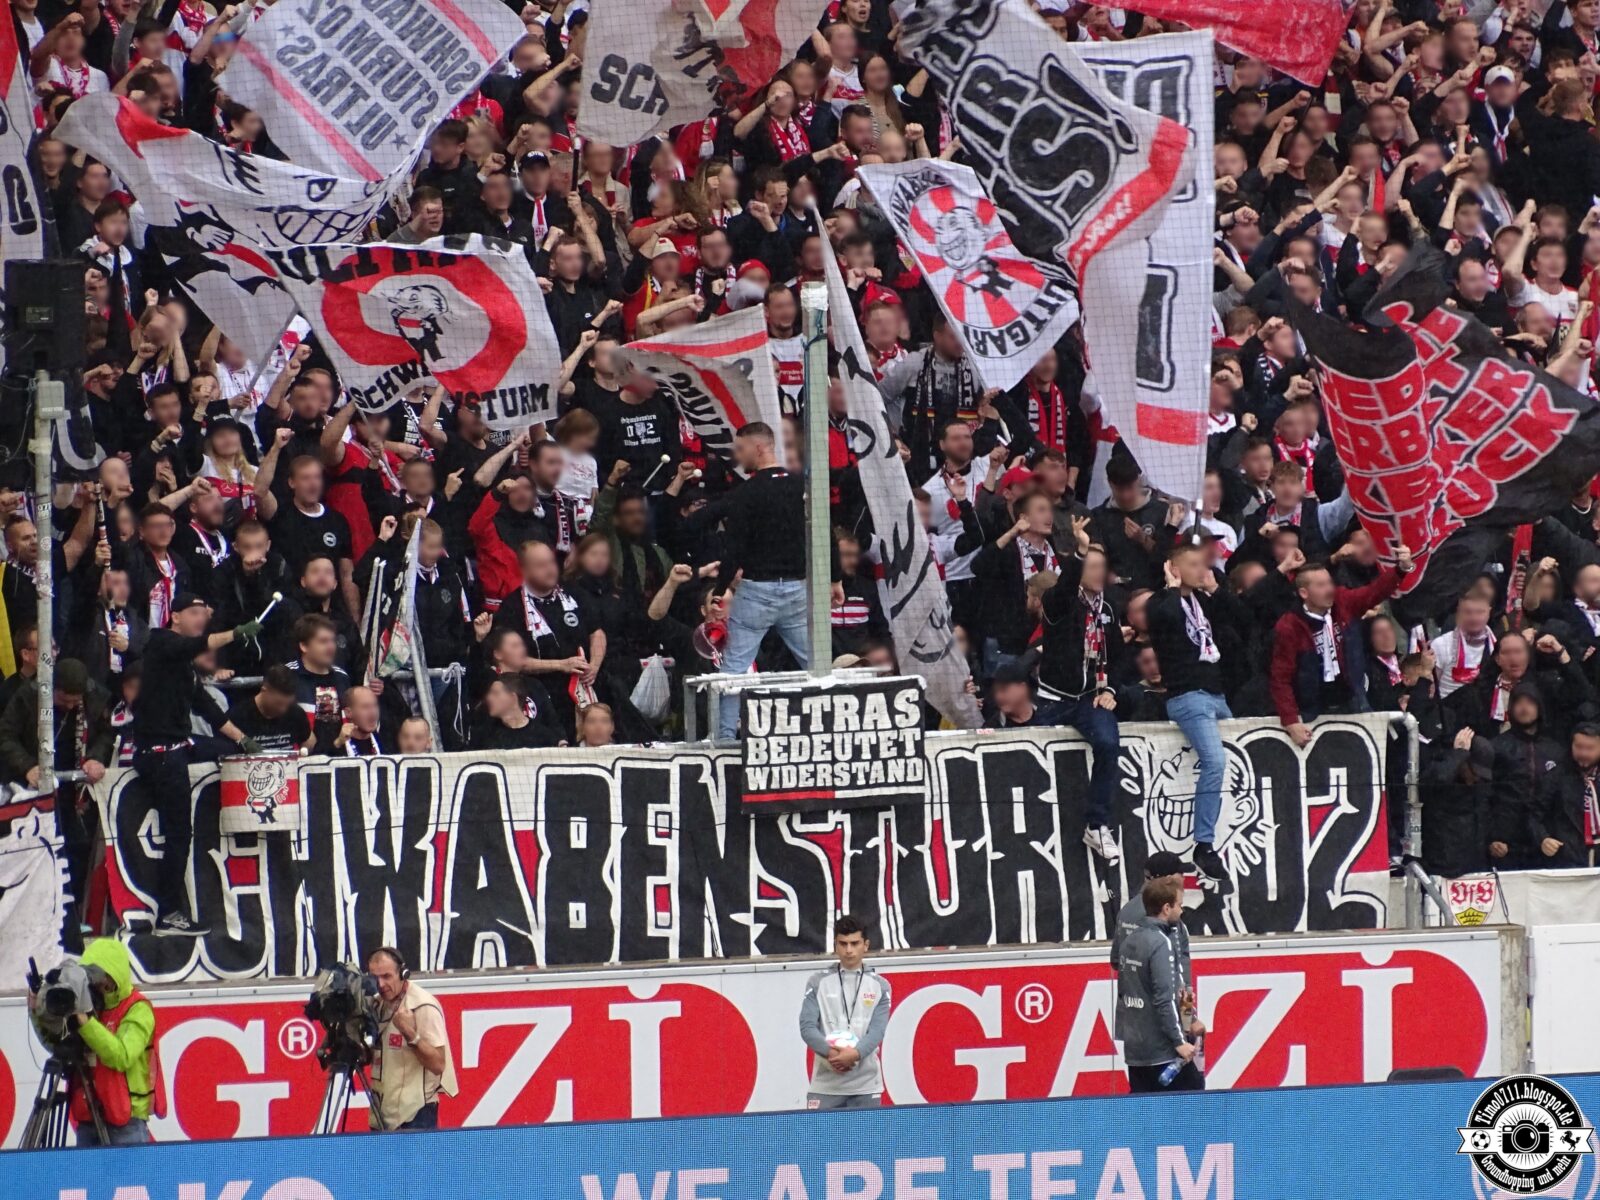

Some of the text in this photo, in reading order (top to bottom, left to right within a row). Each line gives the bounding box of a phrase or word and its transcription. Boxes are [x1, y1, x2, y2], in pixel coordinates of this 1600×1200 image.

[747, 688, 921, 736] ULTRAS
[747, 727, 921, 765] BEDEUTET
[745, 757, 923, 791] WIDERSTAND
[973, 1143, 1234, 1200] TEAM
